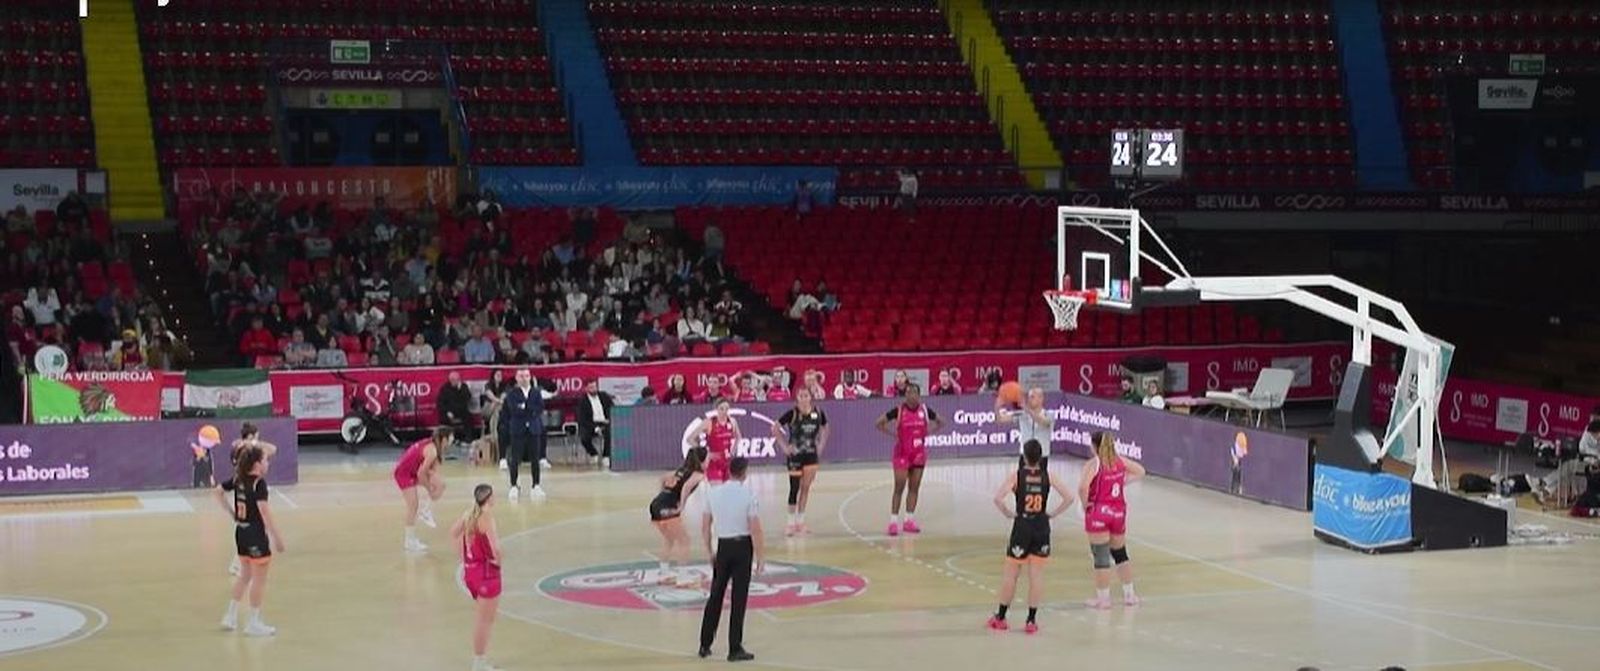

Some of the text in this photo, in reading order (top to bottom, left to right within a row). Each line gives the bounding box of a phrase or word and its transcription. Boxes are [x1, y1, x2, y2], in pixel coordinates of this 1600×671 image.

[331, 69, 383, 81] SEVILLA
[1112, 142, 1130, 166] 24
[1146, 142, 1178, 166] 24
[13, 183, 59, 196] Sevilla
[1195, 195, 1260, 208] SEVILLA
[1440, 196, 1509, 209] SEVILLA
[1108, 364, 1123, 376] IM
[1233, 360, 1258, 372] IMD
[76, 371, 155, 381] VERDIRROJA
[556, 377, 583, 392] MD
[1470, 392, 1489, 408] IMD
[953, 409, 996, 427] Grupo
[1079, 409, 1111, 429] Servicios
[1559, 404, 1580, 421] IMD
[988, 432, 1006, 445] en
[7, 441, 32, 458] de
[7, 463, 90, 482] Laborales
[1111, 482, 1121, 498] 8
[1024, 494, 1043, 513] 28
